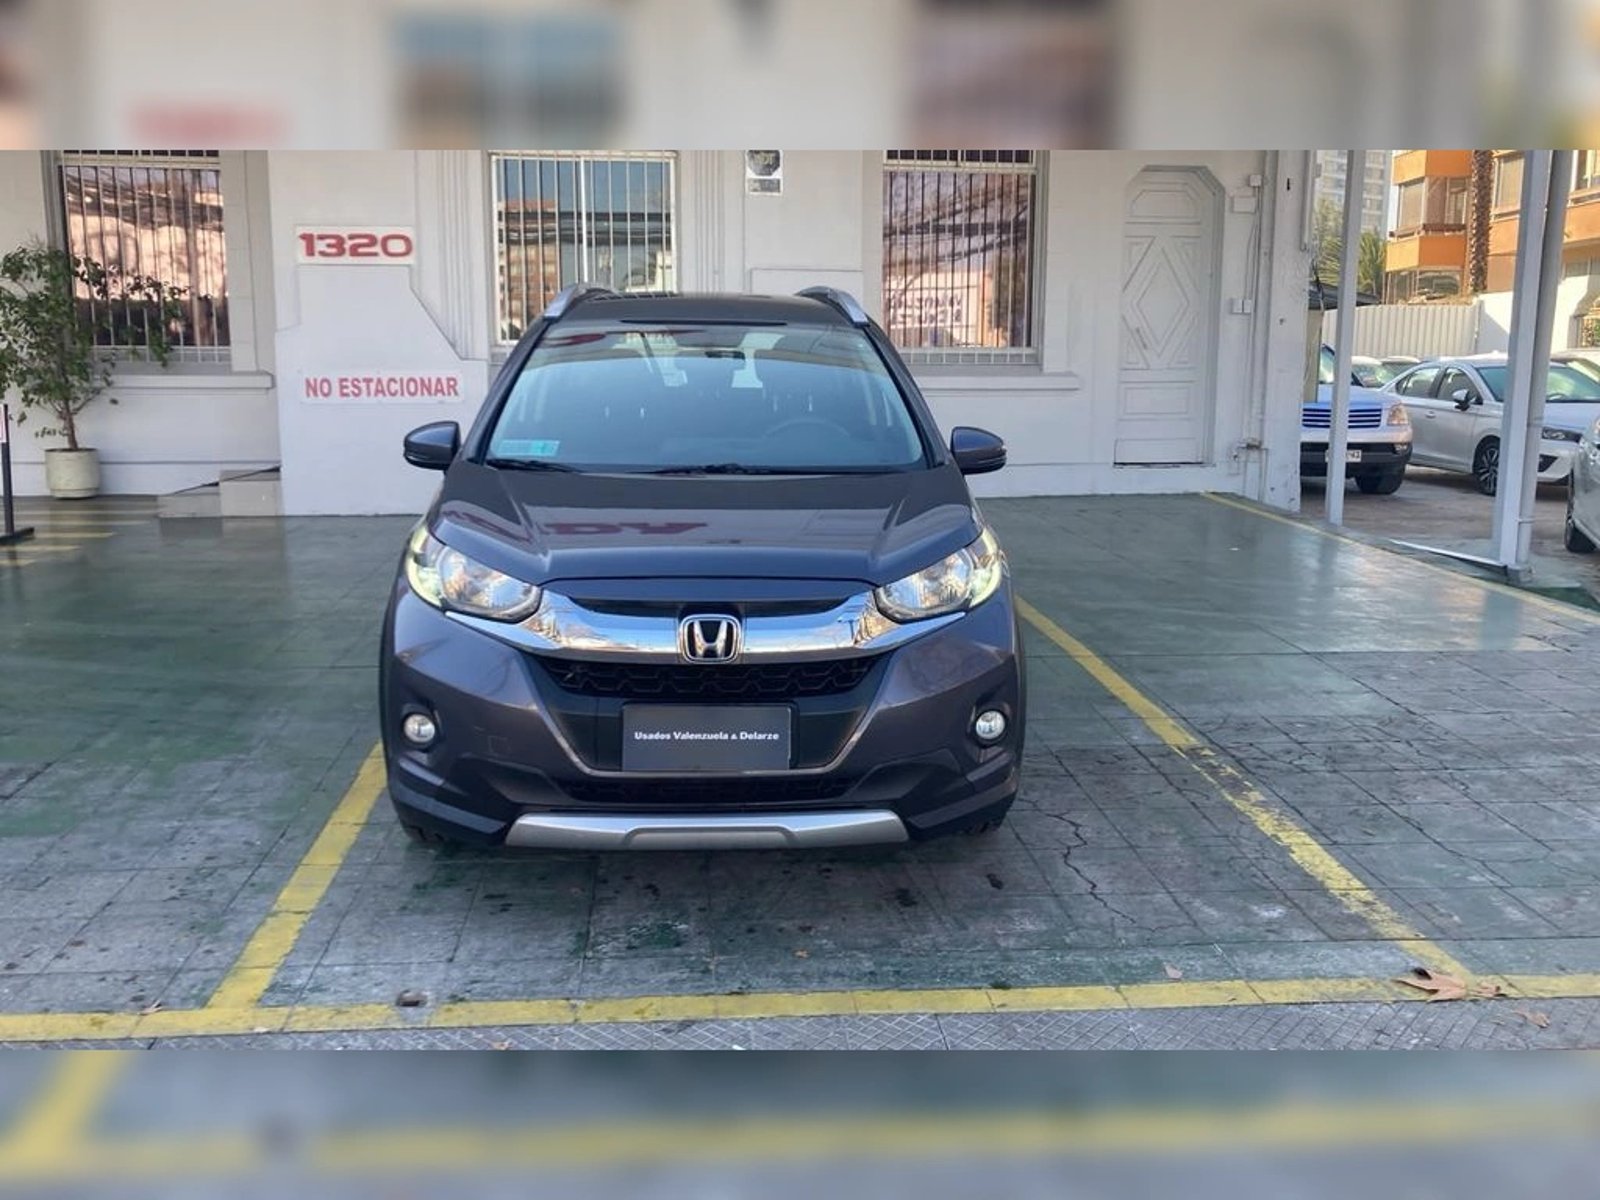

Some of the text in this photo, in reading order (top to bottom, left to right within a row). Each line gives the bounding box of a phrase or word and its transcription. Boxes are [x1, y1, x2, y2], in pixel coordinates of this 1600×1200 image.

[298, 233, 413, 257] 1320
[305, 377, 459, 398] NO ESTACIONAR
[634, 731, 671, 740] Usados
[673, 731, 729, 740] Valenzuela
